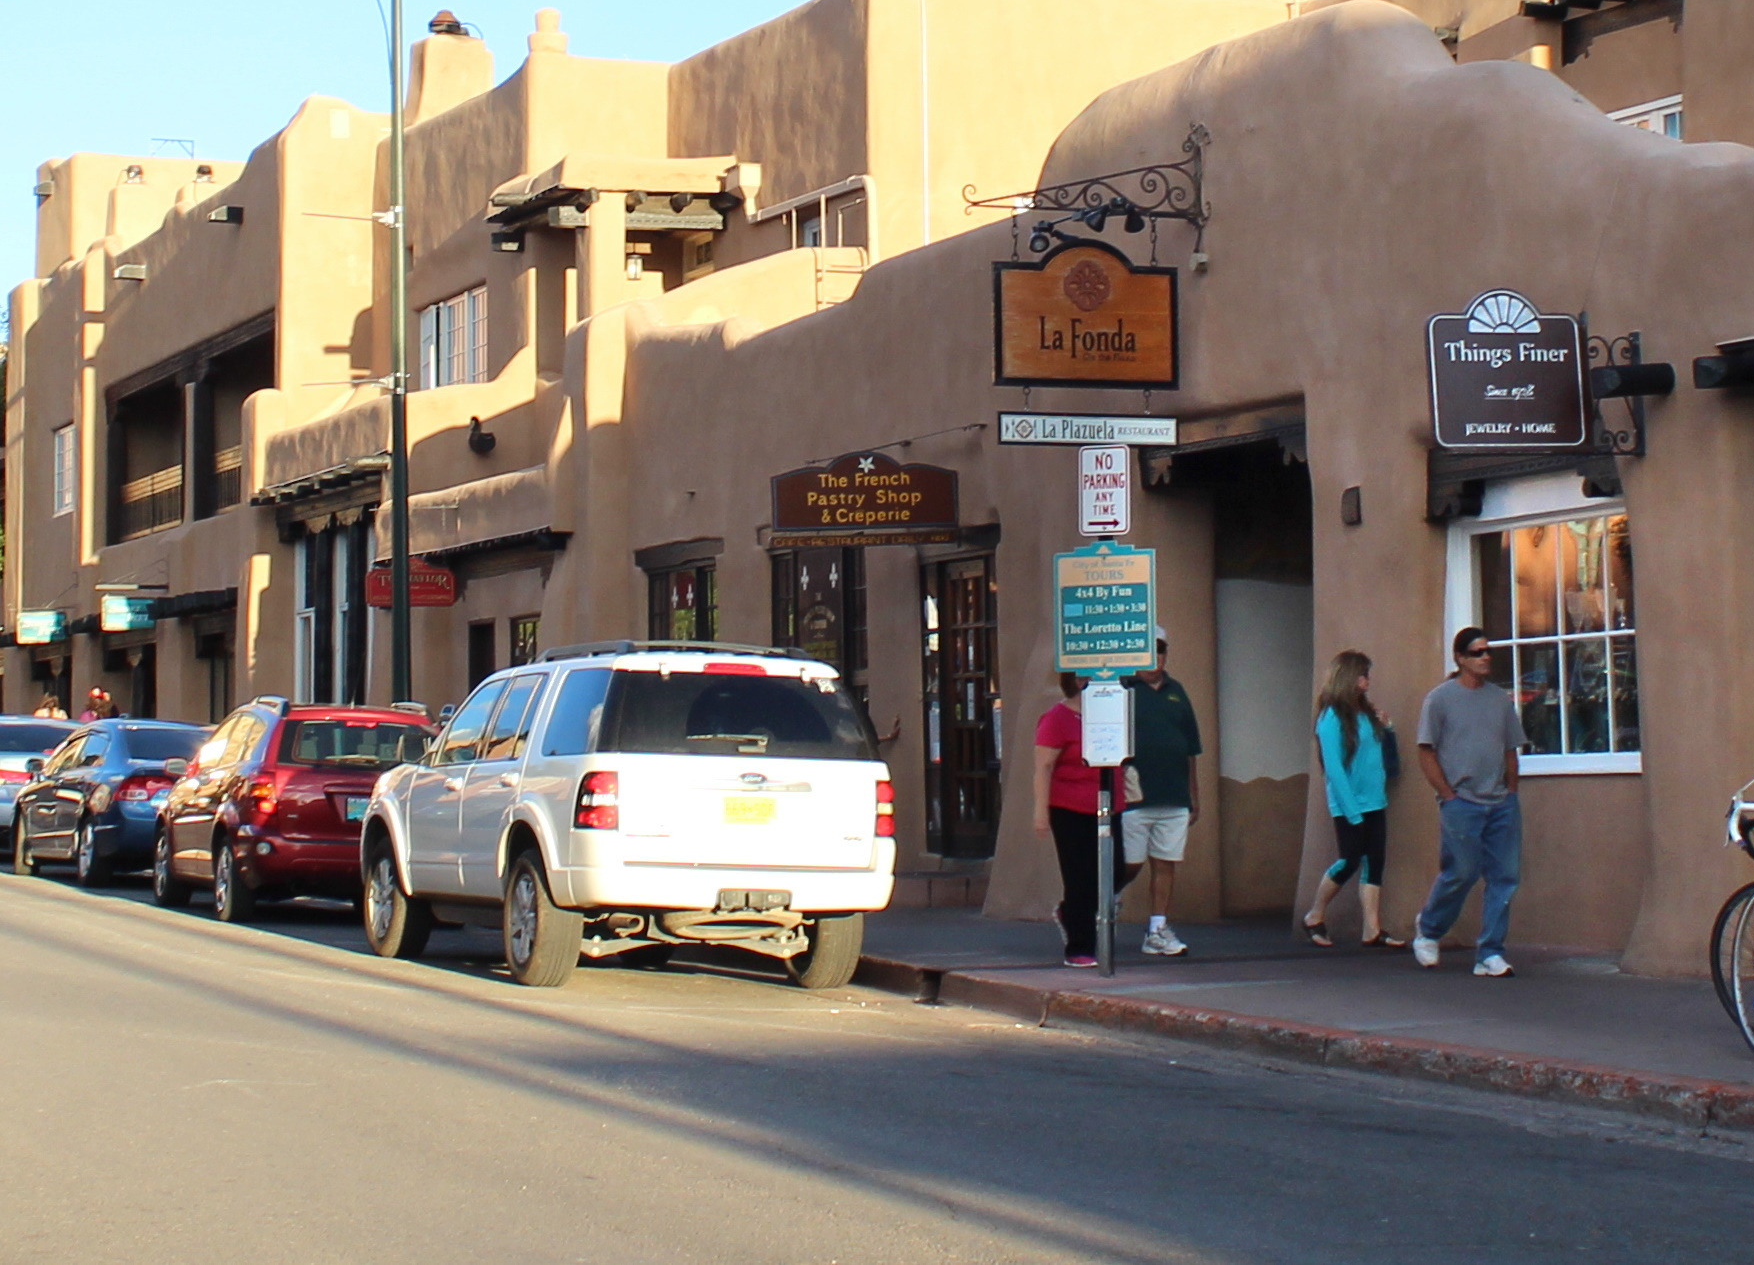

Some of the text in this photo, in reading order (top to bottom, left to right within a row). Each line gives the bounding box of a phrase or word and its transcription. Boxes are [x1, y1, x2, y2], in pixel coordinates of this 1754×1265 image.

[1039, 316, 1137, 358] La Fonda
[1444, 340, 1569, 368] Things Finer
[1042, 419, 1171, 440] La Plazuela RESTAURANT
[1465, 423, 1556, 436] JEWELRY HOME
[1095, 454, 1113, 470] NO
[818, 472, 910, 488] The French
[1083, 473, 1126, 490] PARKING
[807, 490, 922, 508] Pastry Shop
[1095, 492, 1114, 503] ANY
[821, 508, 832, 523] &
[1093, 504, 1116, 516] TIME
[1084, 570, 1124, 581] TOURS
[1075, 585, 1133, 600] 4x4 By Fun
[1109, 603, 1125, 613] 1:30
[1064, 621, 1147, 635] The Loretto Line
[1096, 639, 1119, 650] 12:30
